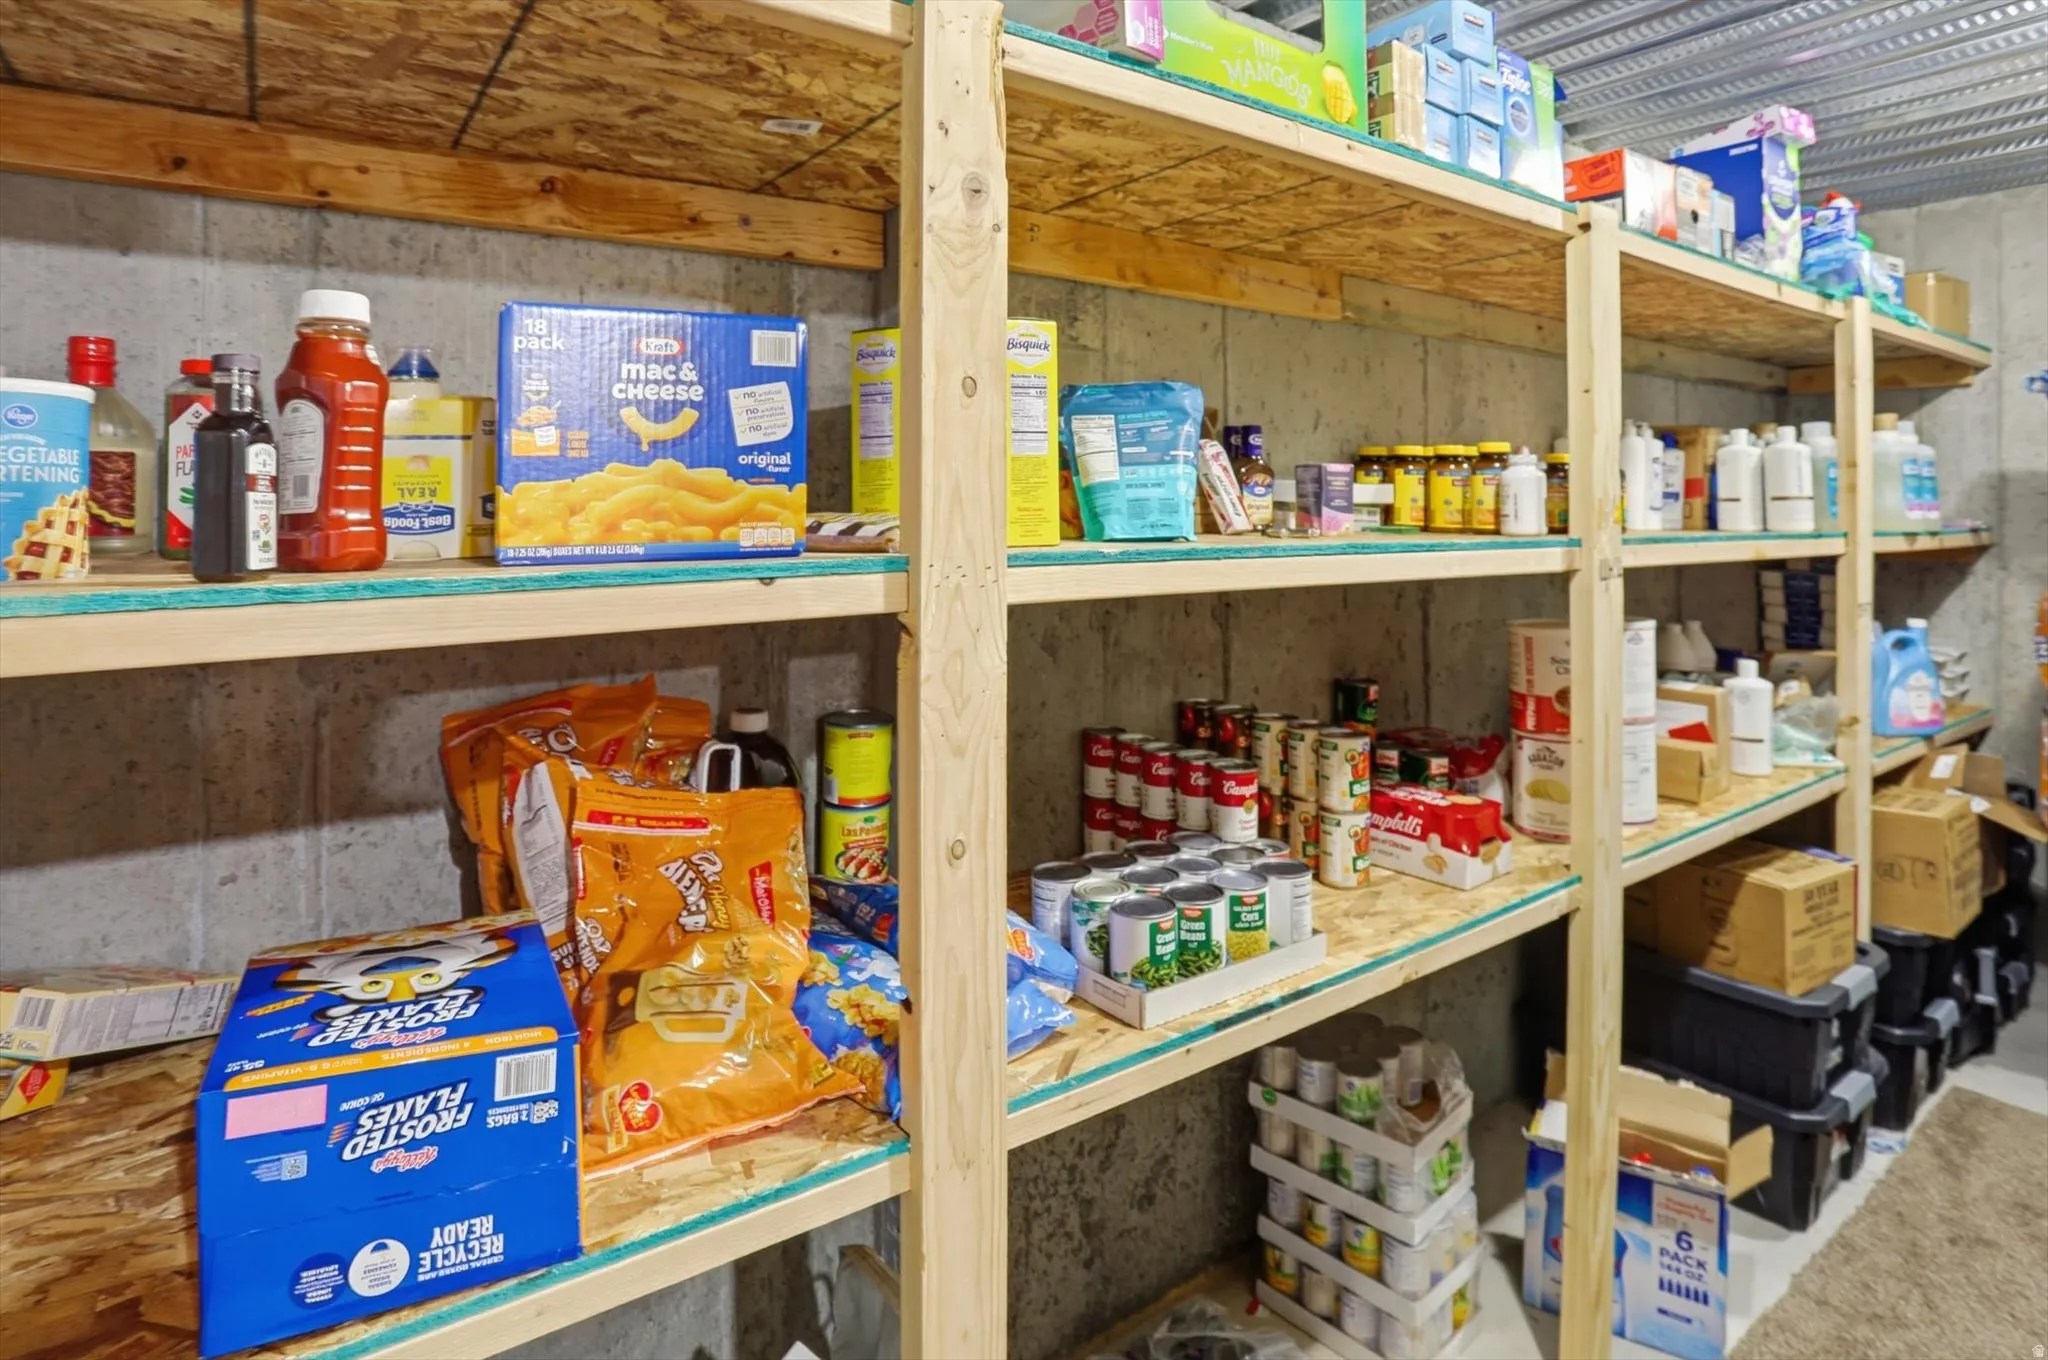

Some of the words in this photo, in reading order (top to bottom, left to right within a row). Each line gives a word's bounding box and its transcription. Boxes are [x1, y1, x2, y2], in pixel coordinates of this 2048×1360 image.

[524, 318, 548, 335] 18
[513, 332, 565, 353] pack
[644, 340, 675, 354] Kraft
[1006, 337, 1051, 353] Bisquick
[620, 362, 677, 381] mac
[678, 361, 698, 381] &
[743, 390, 757, 400] no
[745, 406, 759, 416] no
[748, 424, 763, 433] no
[738, 451, 792, 467] original
[767, 465, 791, 473] flavor
[397, 486, 438, 499] REAL
[383, 517, 421, 530] Foods
[422, 514, 451, 528] Best
[706, 884, 731, 930] Honey
[330, 996, 468, 1029] FLAKES
[307, 1002, 481, 1046] FROSTED
[350, 1026, 446, 1049] Kellogg's
[355, 1082, 469, 1136] FLAKES
[521, 1111, 529, 1123] 2
[487, 1113, 519, 1129] BAGS
[342, 1101, 474, 1161] FROSTED
[371, 1146, 440, 1173] Kellogg's
[430, 1214, 494, 1249] READY
[1675, 1229, 1694, 1252] 6
[417, 1233, 505, 1274] RECYCLE
[1659, 1246, 1708, 1274] PACK
